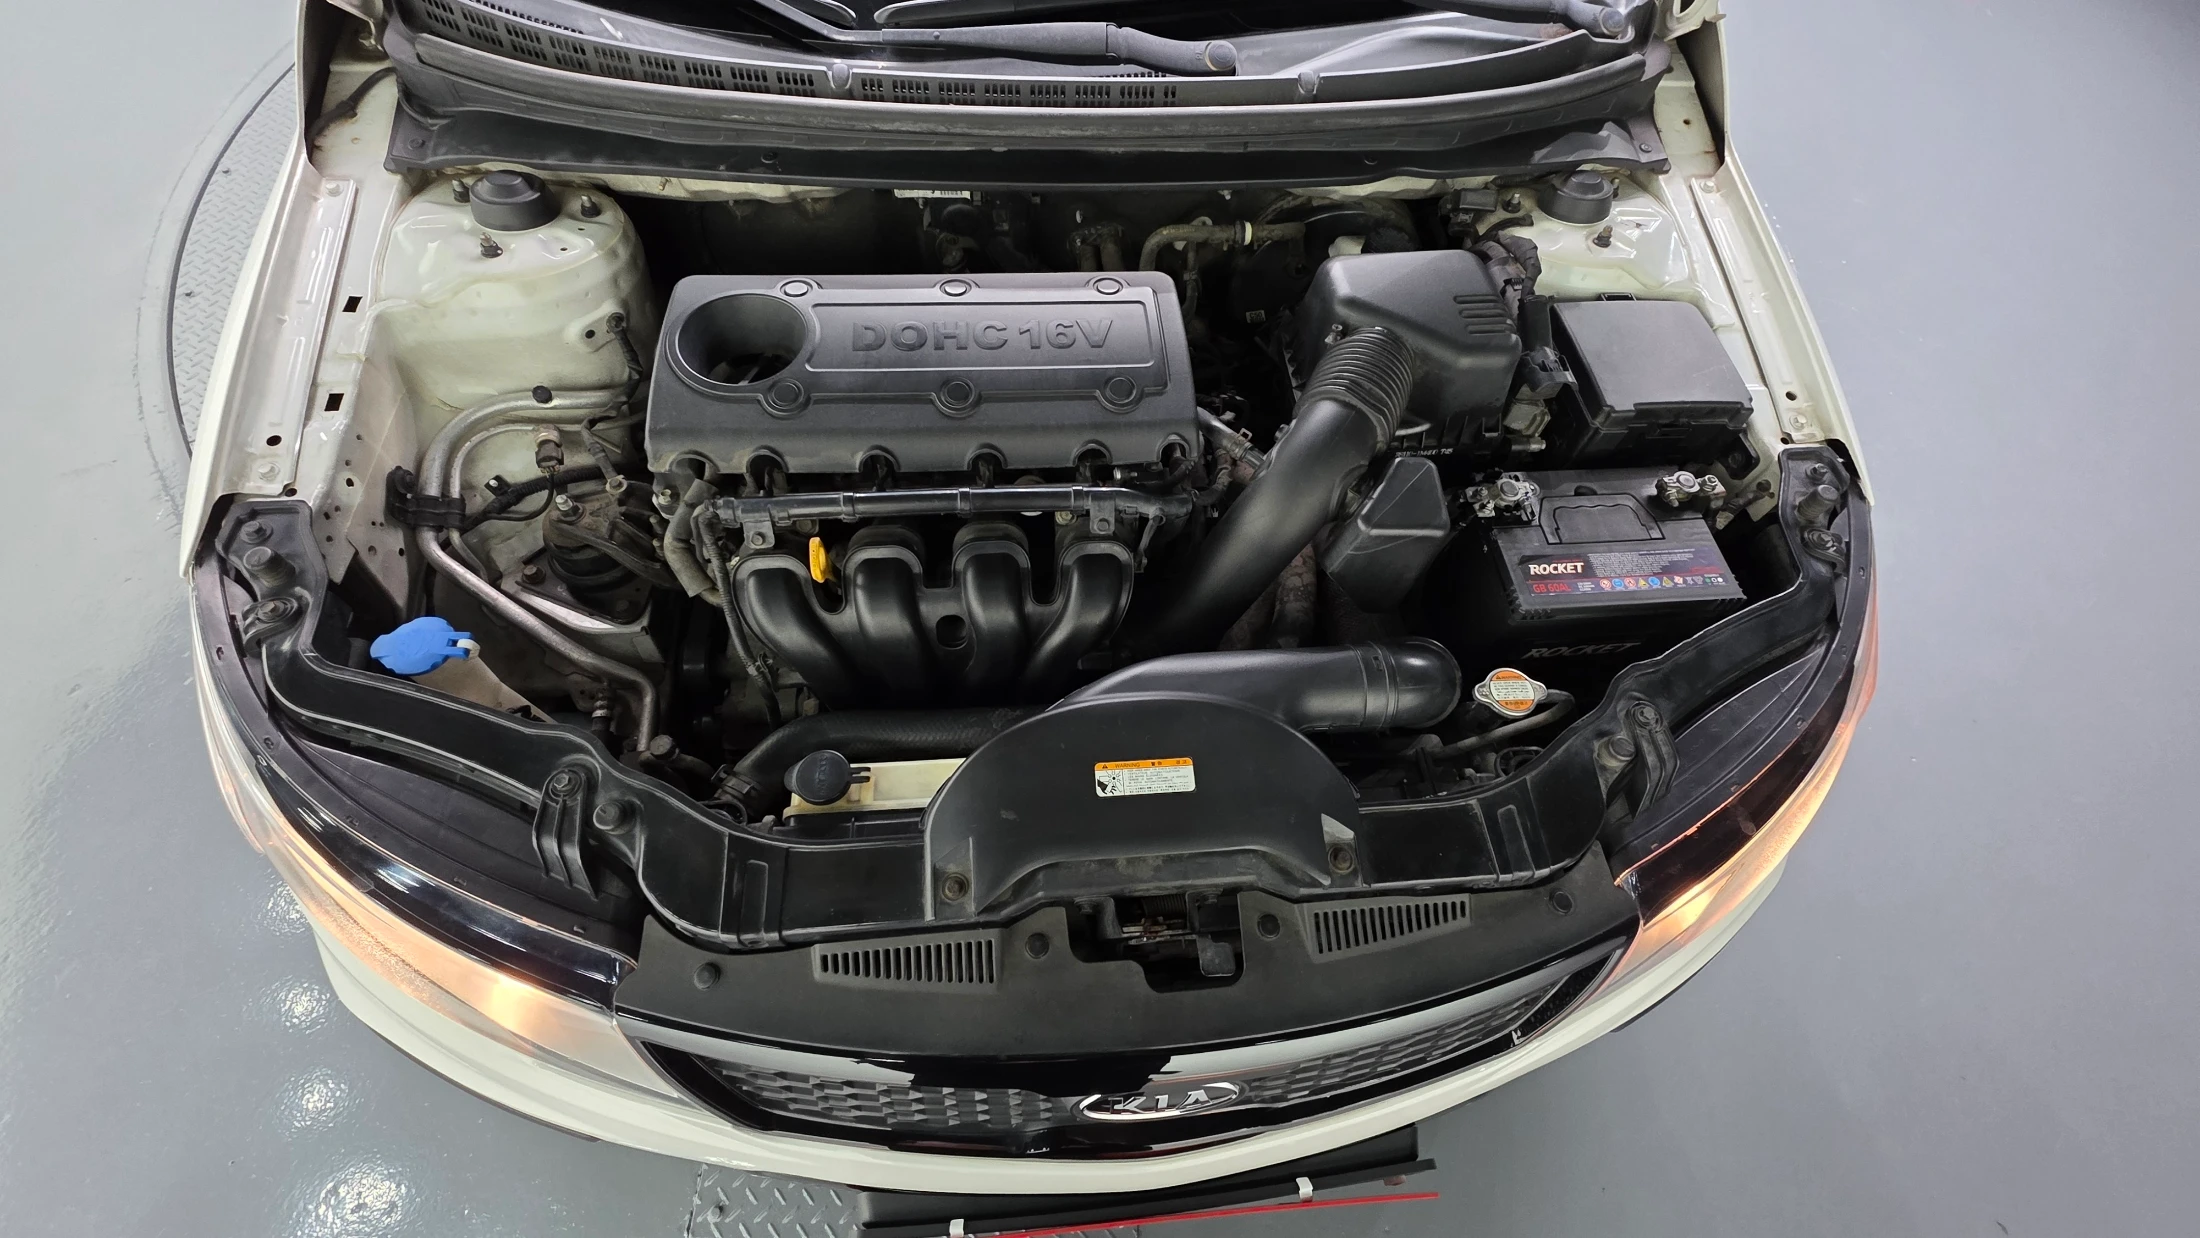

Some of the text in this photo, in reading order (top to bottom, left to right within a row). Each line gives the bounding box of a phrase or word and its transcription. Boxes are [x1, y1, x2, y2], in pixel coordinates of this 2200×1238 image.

[852, 318, 1113, 352] DOHC 16V
[1528, 562, 1585, 575] ROCKET
[1533, 583, 1547, 593] GB
[1548, 582, 1571, 592] 60AL
[1520, 642, 1641, 659] ROCKET
[1108, 1089, 1212, 1114] KIA
